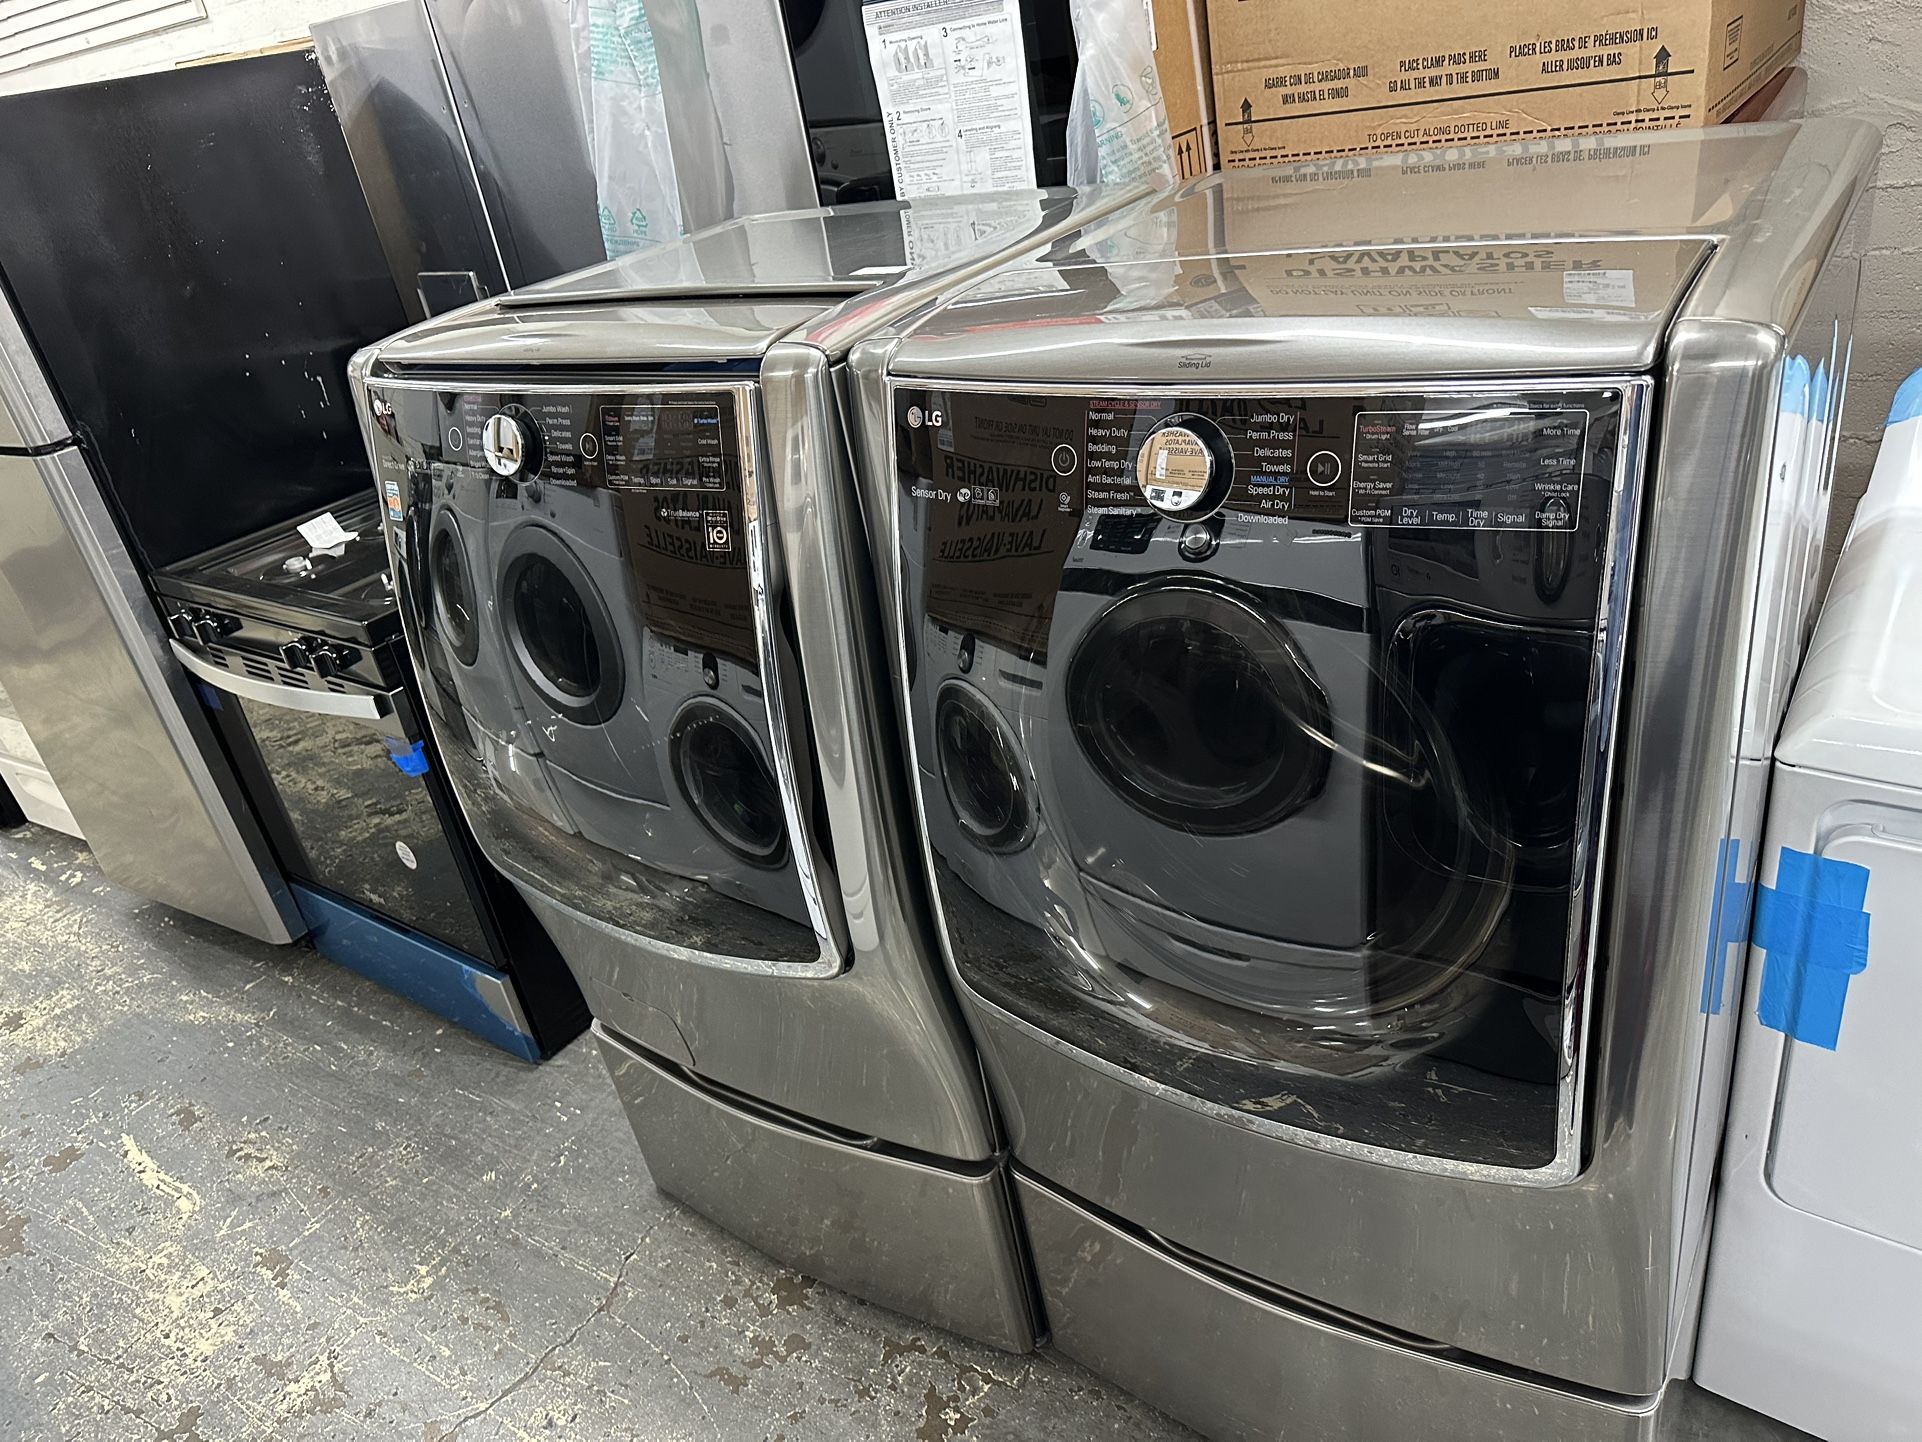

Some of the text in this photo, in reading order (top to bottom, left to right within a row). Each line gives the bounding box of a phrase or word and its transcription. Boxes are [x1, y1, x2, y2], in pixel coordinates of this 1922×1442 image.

[1509, 43, 1537, 58] PLACER
[1539, 40, 1553, 55] LES
[1554, 37, 1576, 53] BRAS
[1593, 27, 1645, 48] PRÉHENSION
[1646, 26, 1659, 41] ICI
[1399, 49, 1488, 73] PLACE CLAMP PADS HERE
[1541, 52, 1623, 74] ALLER JUSQU'EN BAS
[1264, 65, 1368, 90] AGARRE CON DEL CARGADOR AQUI
[1388, 67, 1500, 93] GO ALL THE WAY TO THE BOTTOM
[1281, 86, 1349, 105] VAYA HASTA EL FONDO
[1367, 119, 1510, 144] TO OPEN CUT ALONG DOTTED LINE
[886, 111, 906, 197] BY CUSTOMER ONLY
[1178, 360, 1212, 370] Sliding Lid
[381, 403, 392, 414] LG
[542, 405, 570, 413] Jumbo Wash
[924, 411, 942, 427] LG
[1088, 411, 1114, 421] Normal
[1251, 413, 1295, 424] Jumbo Dry
[551, 430, 572, 438] Delicates
[1088, 428, 1129, 438] Heavy Duty
[1360, 425, 1396, 433] TurboSteam
[1543, 428, 1581, 436] More Time
[1247, 430, 1293, 440] Perm.Press
[556, 441, 573, 450] Towels
[1088, 443, 1116, 454] Bedding
[1254, 448, 1292, 457] Delicates
[547, 454, 575, 462] Speed Wash
[1540, 458, 1576, 466] Less Time
[1261, 462, 1291, 473] Towels
[550, 477, 577, 487] Downloaded
[650, 476, 661, 484] Spin
[682, 478, 698, 486] Signal
[1087, 474, 1132, 485] Anti Bacterial
[1251, 475, 1276, 483] MANUAL
[1353, 481, 1393, 490] Energy Saver
[1534, 483, 1579, 491] Wrinkle Care
[911, 486, 952, 503] Sensor Dry
[1087, 490, 1109, 499] Steam
[1247, 485, 1290, 497] Speed Dry
[1087, 505, 1108, 514] Steam
[1260, 499, 1290, 511] Air Dry
[1351, 509, 1391, 517] Custom PGM
[1402, 507, 1418, 517] Dry
[1432, 511, 1458, 522] Temp.
[1467, 509, 1488, 518] Time
[1535, 511, 1570, 521] Damp Dry
[1238, 513, 1288, 525] Downloaded
[1398, 516, 1421, 525] Level
[1468, 518, 1485, 528] Dry
[1497, 513, 1526, 523] Signal
[708, 526, 727, 544] 10
